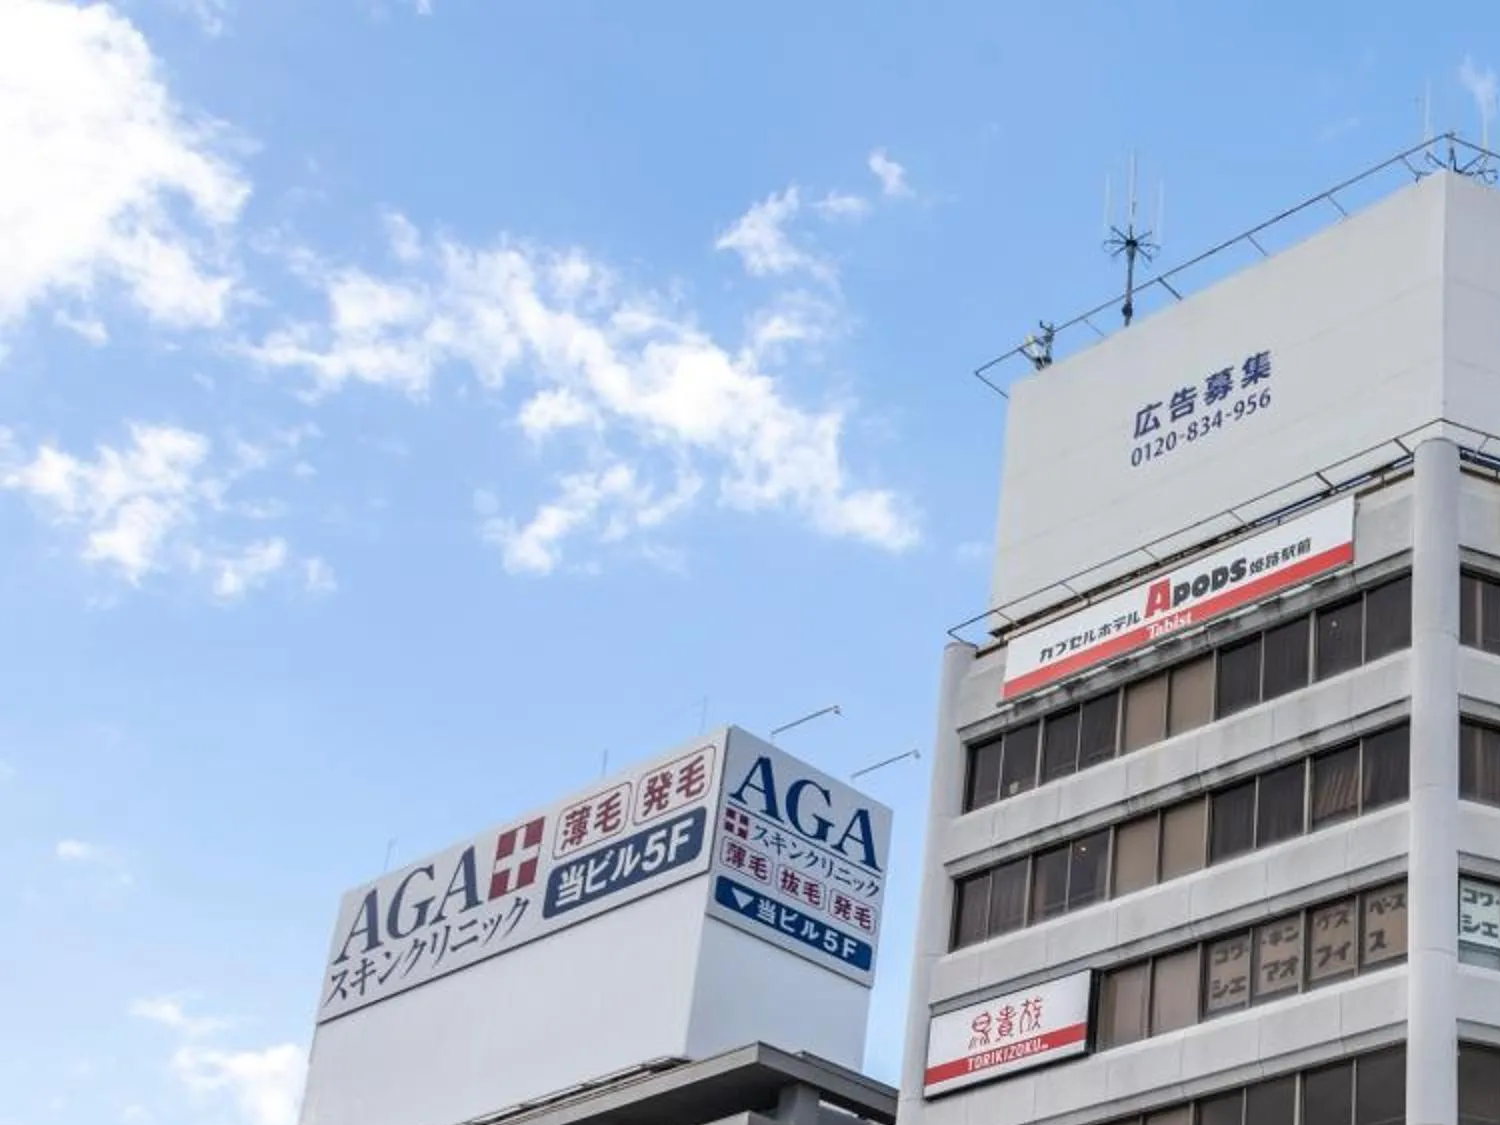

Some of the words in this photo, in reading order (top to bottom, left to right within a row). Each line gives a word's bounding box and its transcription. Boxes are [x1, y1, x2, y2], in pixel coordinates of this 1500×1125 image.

[1130, 388, 1273, 469] 0120-834-956
[1131, 348, 1273, 440] 広告募集
[641, 752, 708, 813] 発毛
[727, 754, 881, 873] AGA
[554, 818, 695, 907] 当ビル5F
[752, 821, 881, 898] スキンクリニック
[332, 845, 481, 966] AGA
[753, 899, 858, 961] 当ビル5F
[831, 888, 874, 930] 発毛
[321, 895, 530, 1010] スキンクリニック
